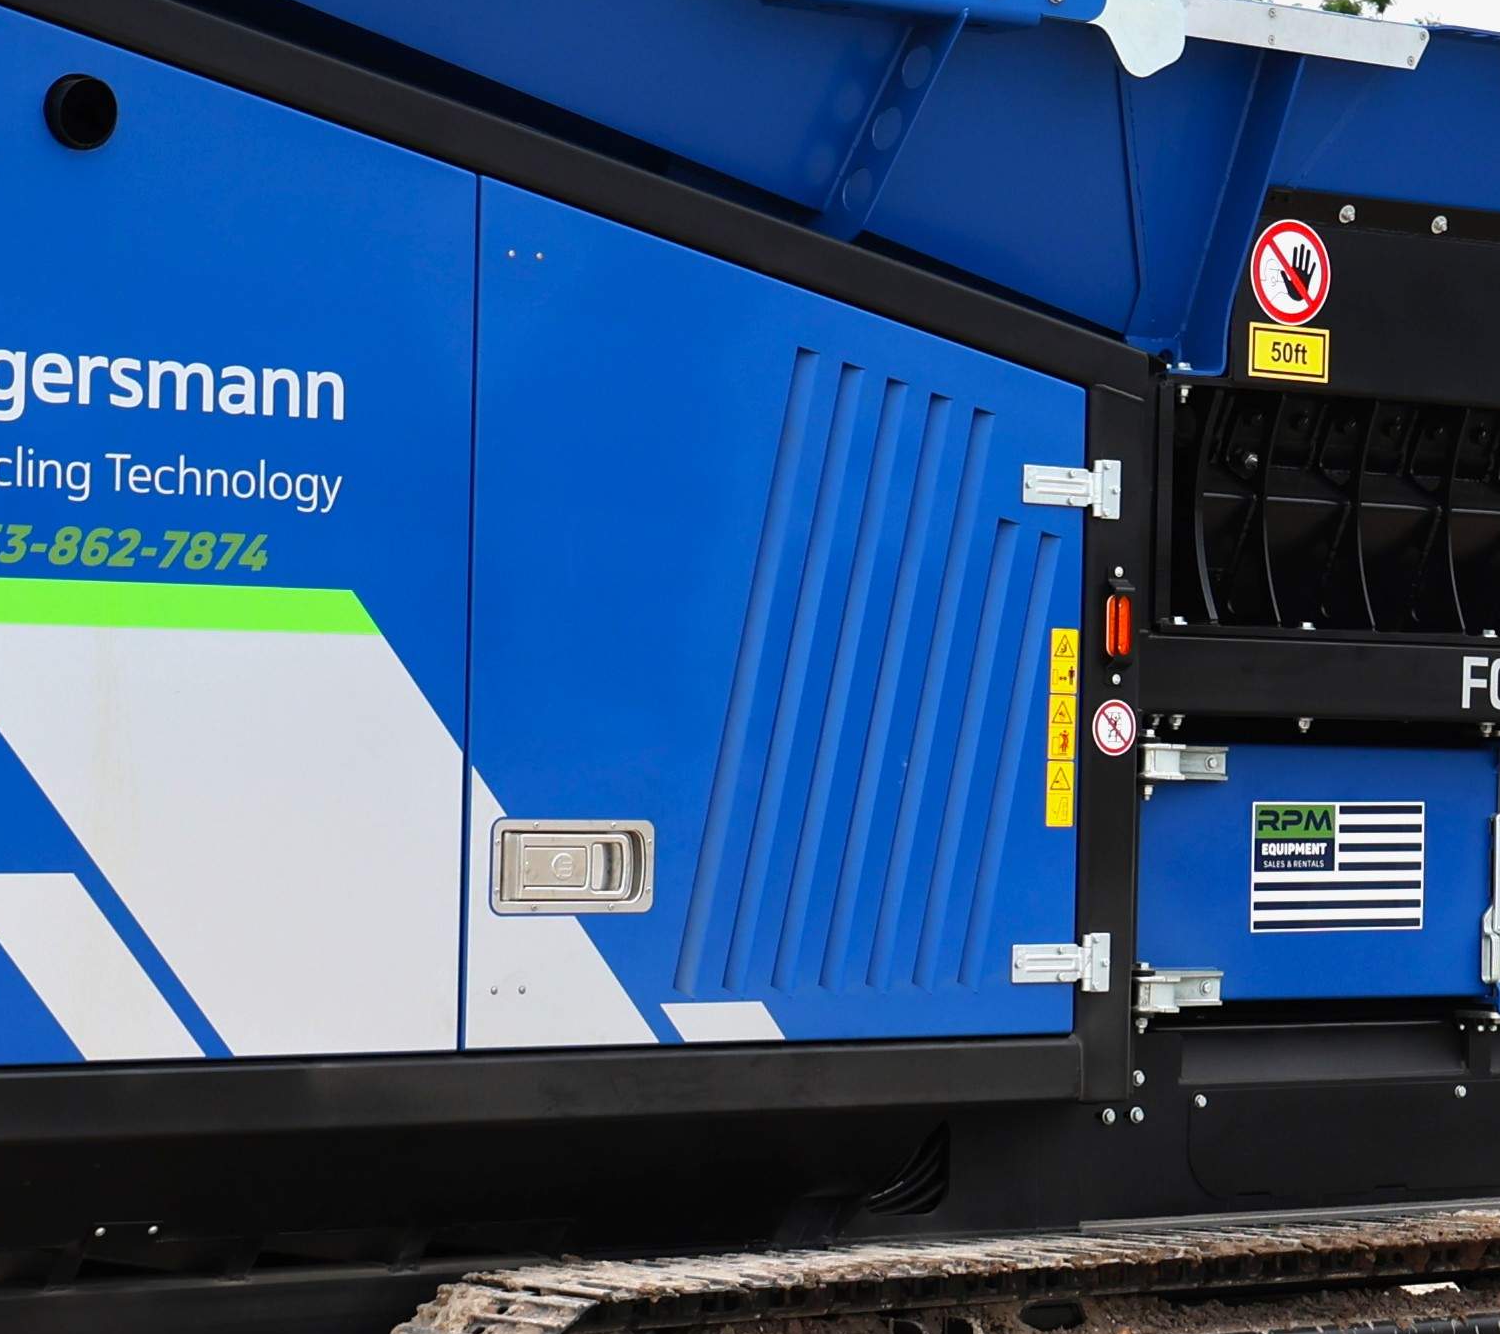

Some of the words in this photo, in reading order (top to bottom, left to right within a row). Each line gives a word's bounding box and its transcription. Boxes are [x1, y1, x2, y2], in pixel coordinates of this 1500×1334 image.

[1271, 341, 1307, 365] 50ft
[104, 452, 343, 513] Technology
[1258, 809, 1332, 831] RPM
[1261, 842, 1327, 856] EQUIPMENT
[1263, 860, 1285, 868] SALES
[1286, 860, 1292, 868] &
[1293, 859, 1325, 868] RENTALS
